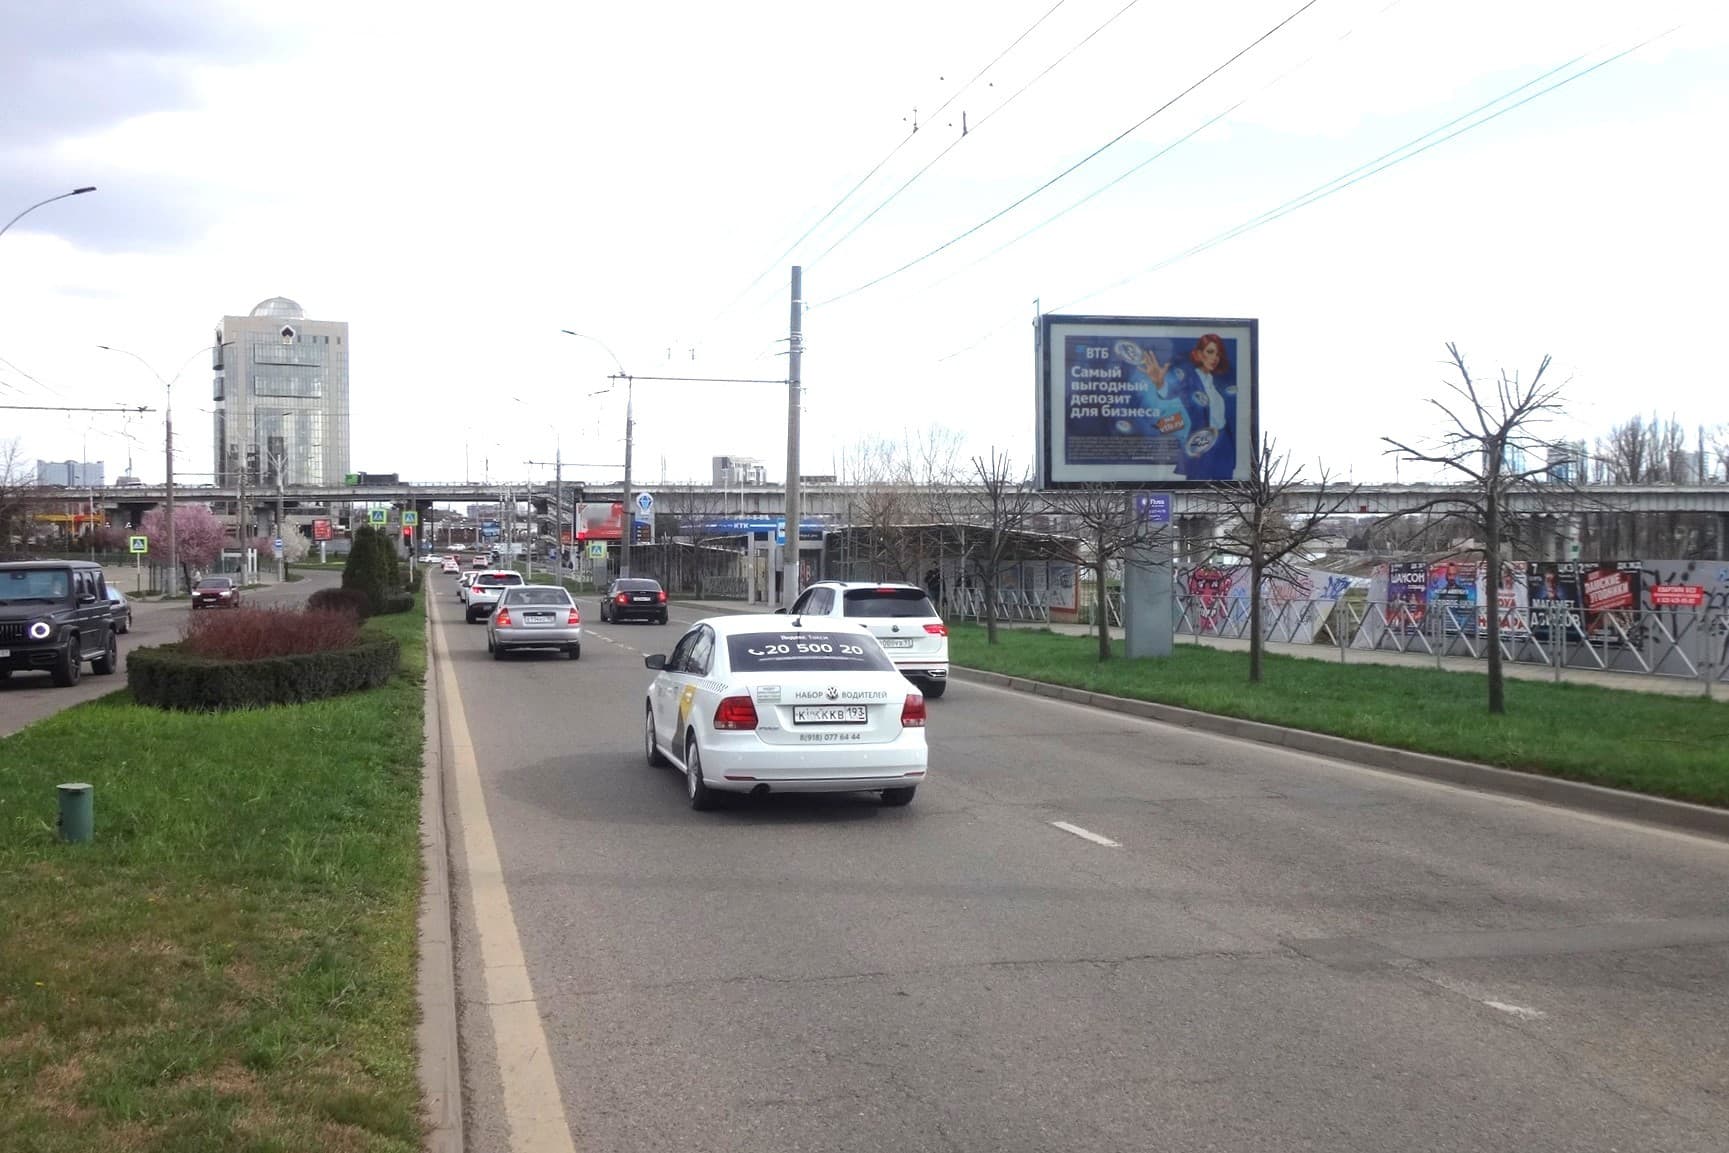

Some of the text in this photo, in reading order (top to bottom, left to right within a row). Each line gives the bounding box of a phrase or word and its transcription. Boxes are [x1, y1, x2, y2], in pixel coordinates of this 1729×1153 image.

[1086, 347, 1109, 359] ВТБ
[1071, 365, 1122, 378] Самый
[1071, 380, 1149, 393] выгодный
[1070, 394, 1132, 406] депозит
[1070, 404, 1161, 419] для бизнеса
[765, 643, 864, 655] 20 500 20
[795, 690, 888, 699] НАБОР ВОДИТЕЛЕЙ
[824, 733, 838, 742] 077
[850, 733, 861, 741] 44
